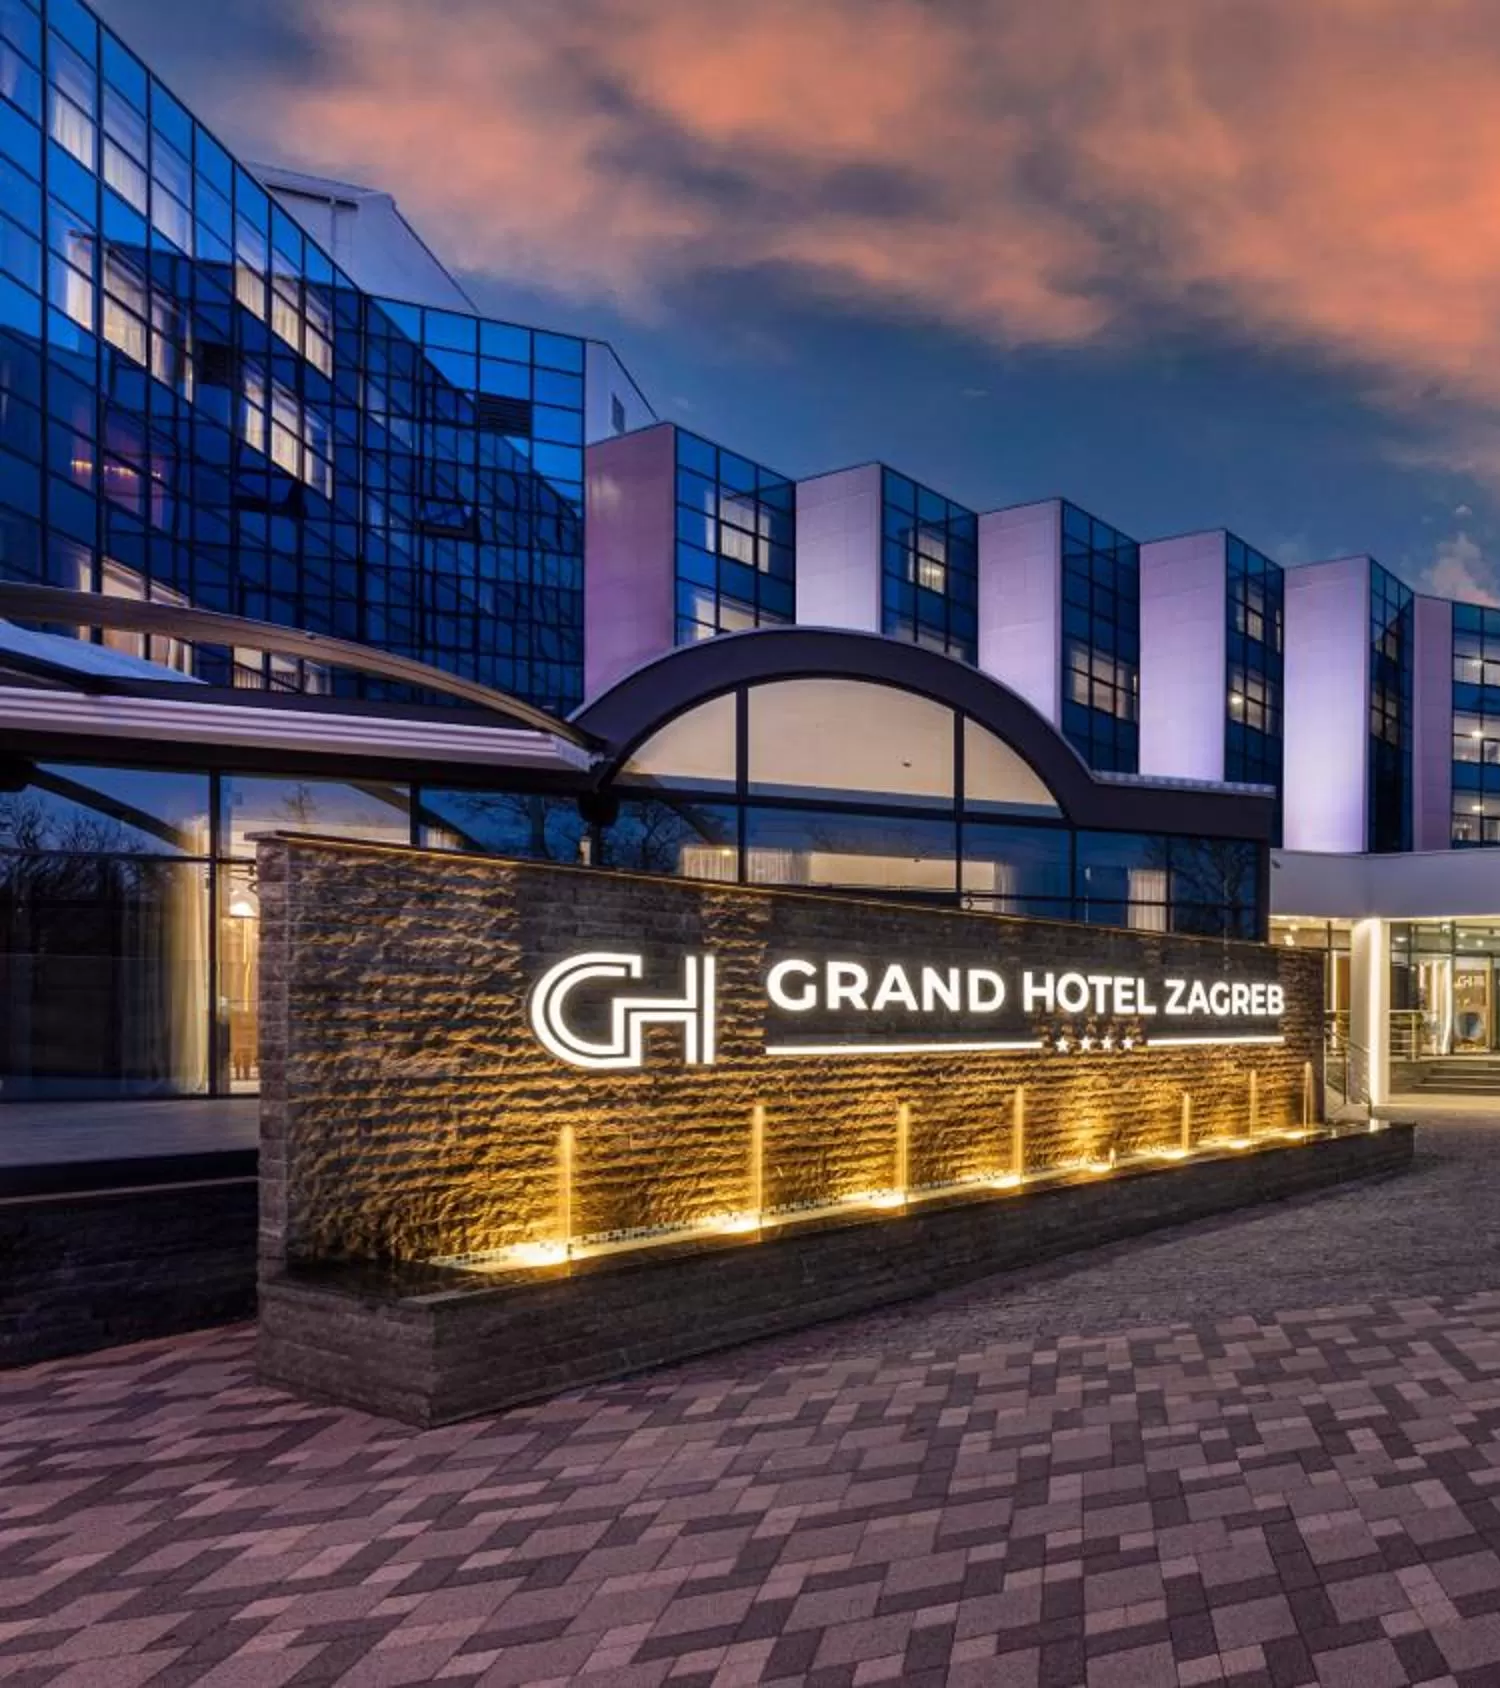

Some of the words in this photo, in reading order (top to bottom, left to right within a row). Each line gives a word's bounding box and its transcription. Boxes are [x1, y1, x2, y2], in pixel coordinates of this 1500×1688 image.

[530, 951, 716, 1070] GH
[765, 958, 1007, 1014] GRAND
[1022, 970, 1157, 1016] HOTEL
[1164, 978, 1285, 1017] ZAGREB
